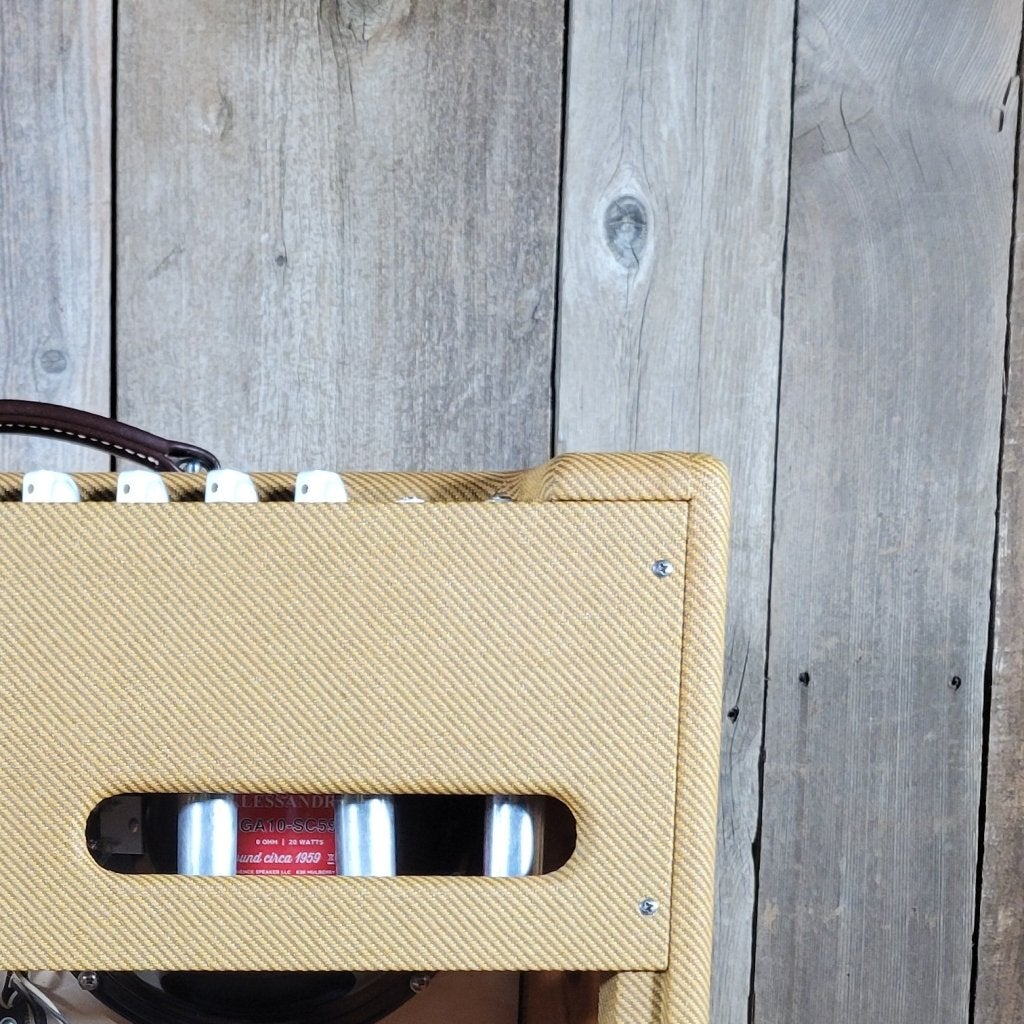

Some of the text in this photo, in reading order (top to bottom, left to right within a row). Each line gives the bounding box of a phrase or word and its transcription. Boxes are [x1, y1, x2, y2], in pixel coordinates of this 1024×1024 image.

[241, 794, 335, 808] LESSANDR
[238, 852, 322, 864] und circa 1959
